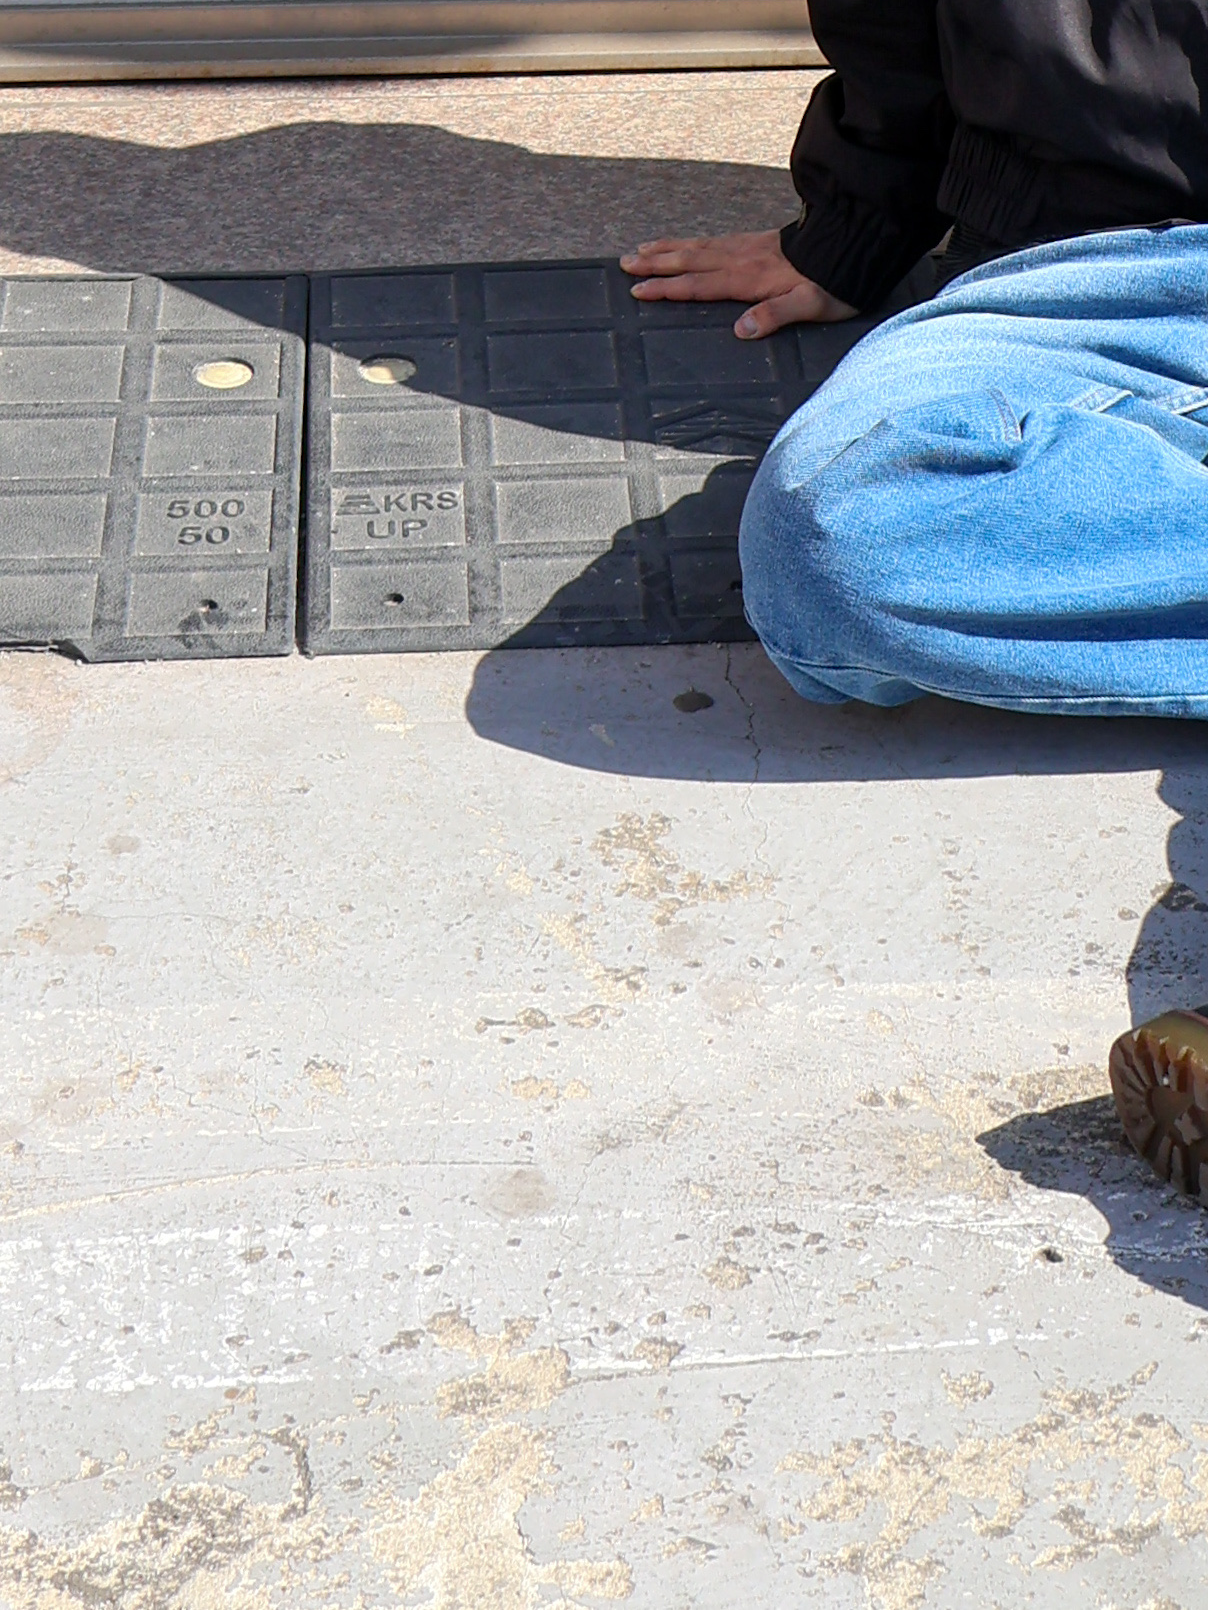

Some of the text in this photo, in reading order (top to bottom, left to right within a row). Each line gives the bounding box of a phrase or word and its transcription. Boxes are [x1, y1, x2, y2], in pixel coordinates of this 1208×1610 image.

[166, 498, 245, 520] 500
[383, 491, 459, 513] KRS
[178, 525, 231, 547] 50
[366, 519, 429, 540] UP
